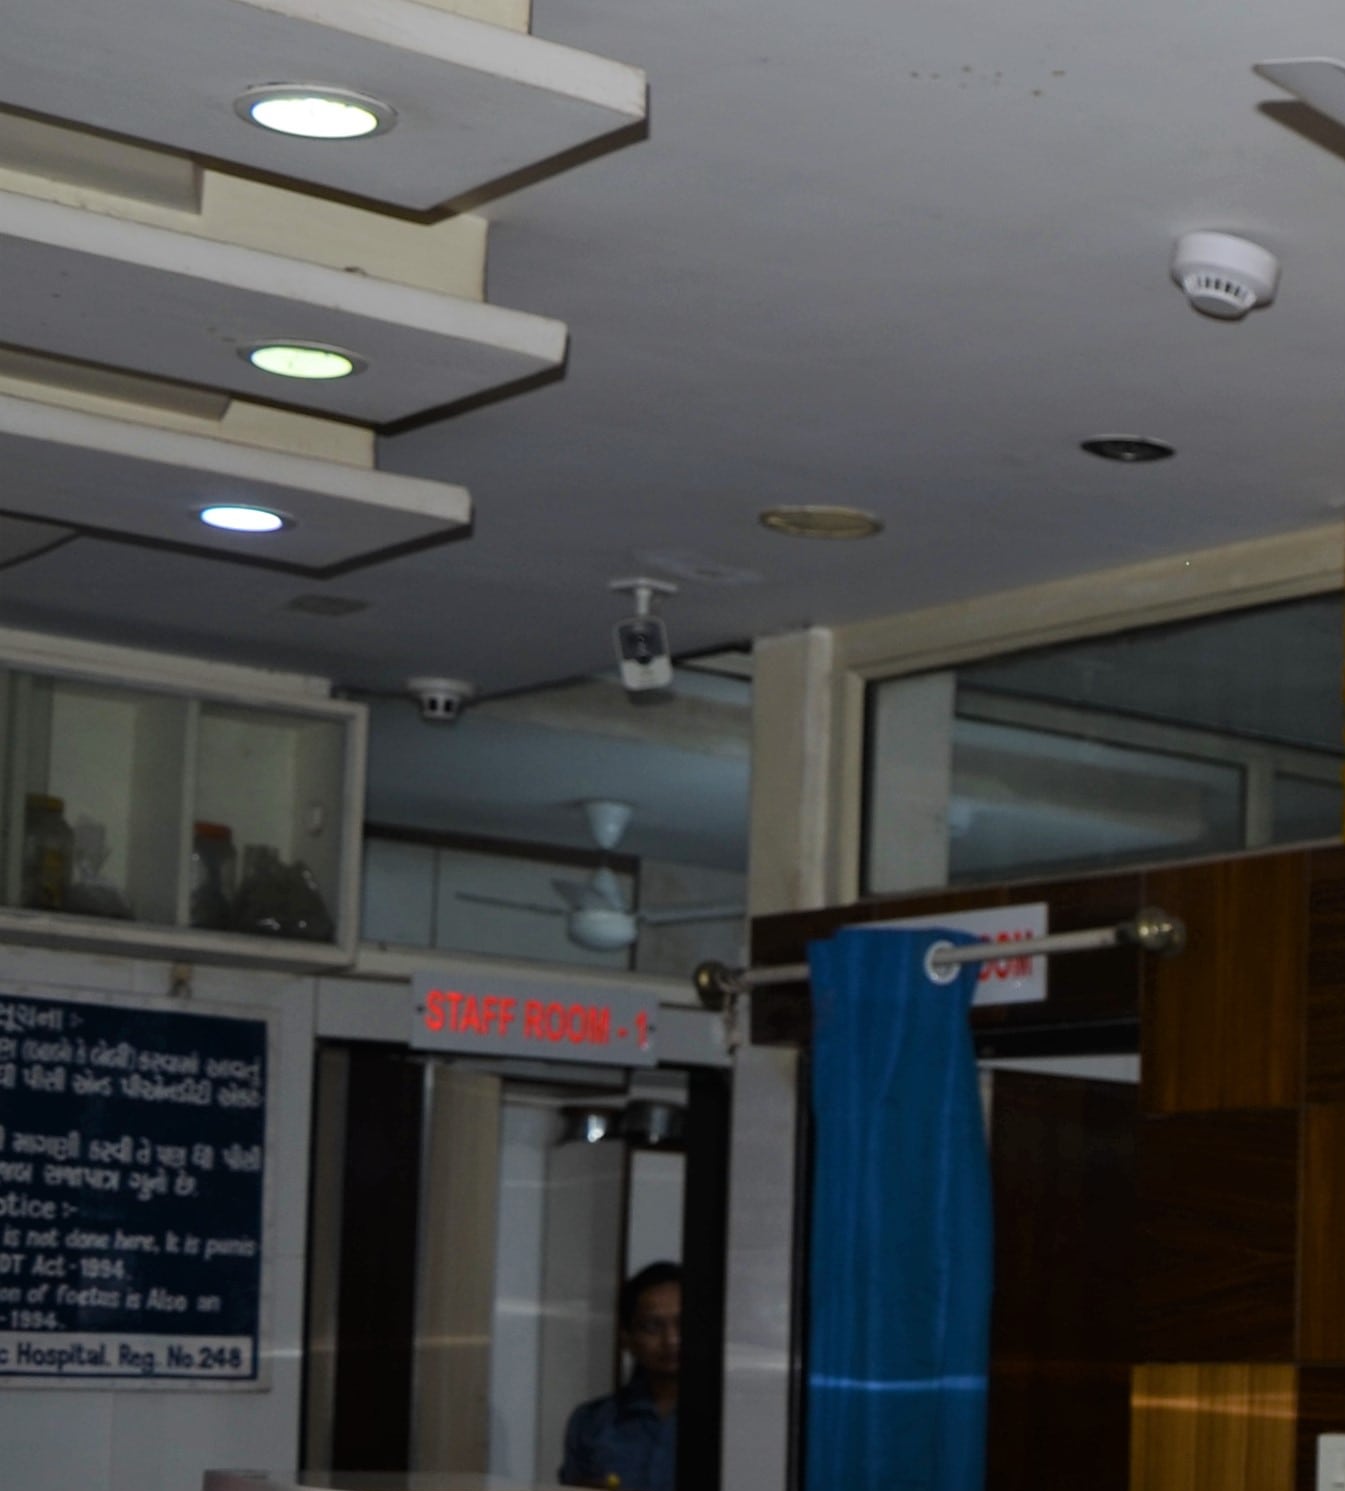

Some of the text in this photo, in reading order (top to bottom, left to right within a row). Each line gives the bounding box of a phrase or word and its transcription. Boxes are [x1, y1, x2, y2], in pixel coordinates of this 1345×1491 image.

[977, 929, 1033, 982] OOM
[426, 989, 516, 1037] STAFF
[524, 999, 610, 1046] ROOM
[635, 1011, 648, 1047] 1
[0, 1191, 57, 1220] otice
[25, 1227, 59, 1248] not
[64, 1228, 110, 1250] done
[27, 1283, 51, 1305] of
